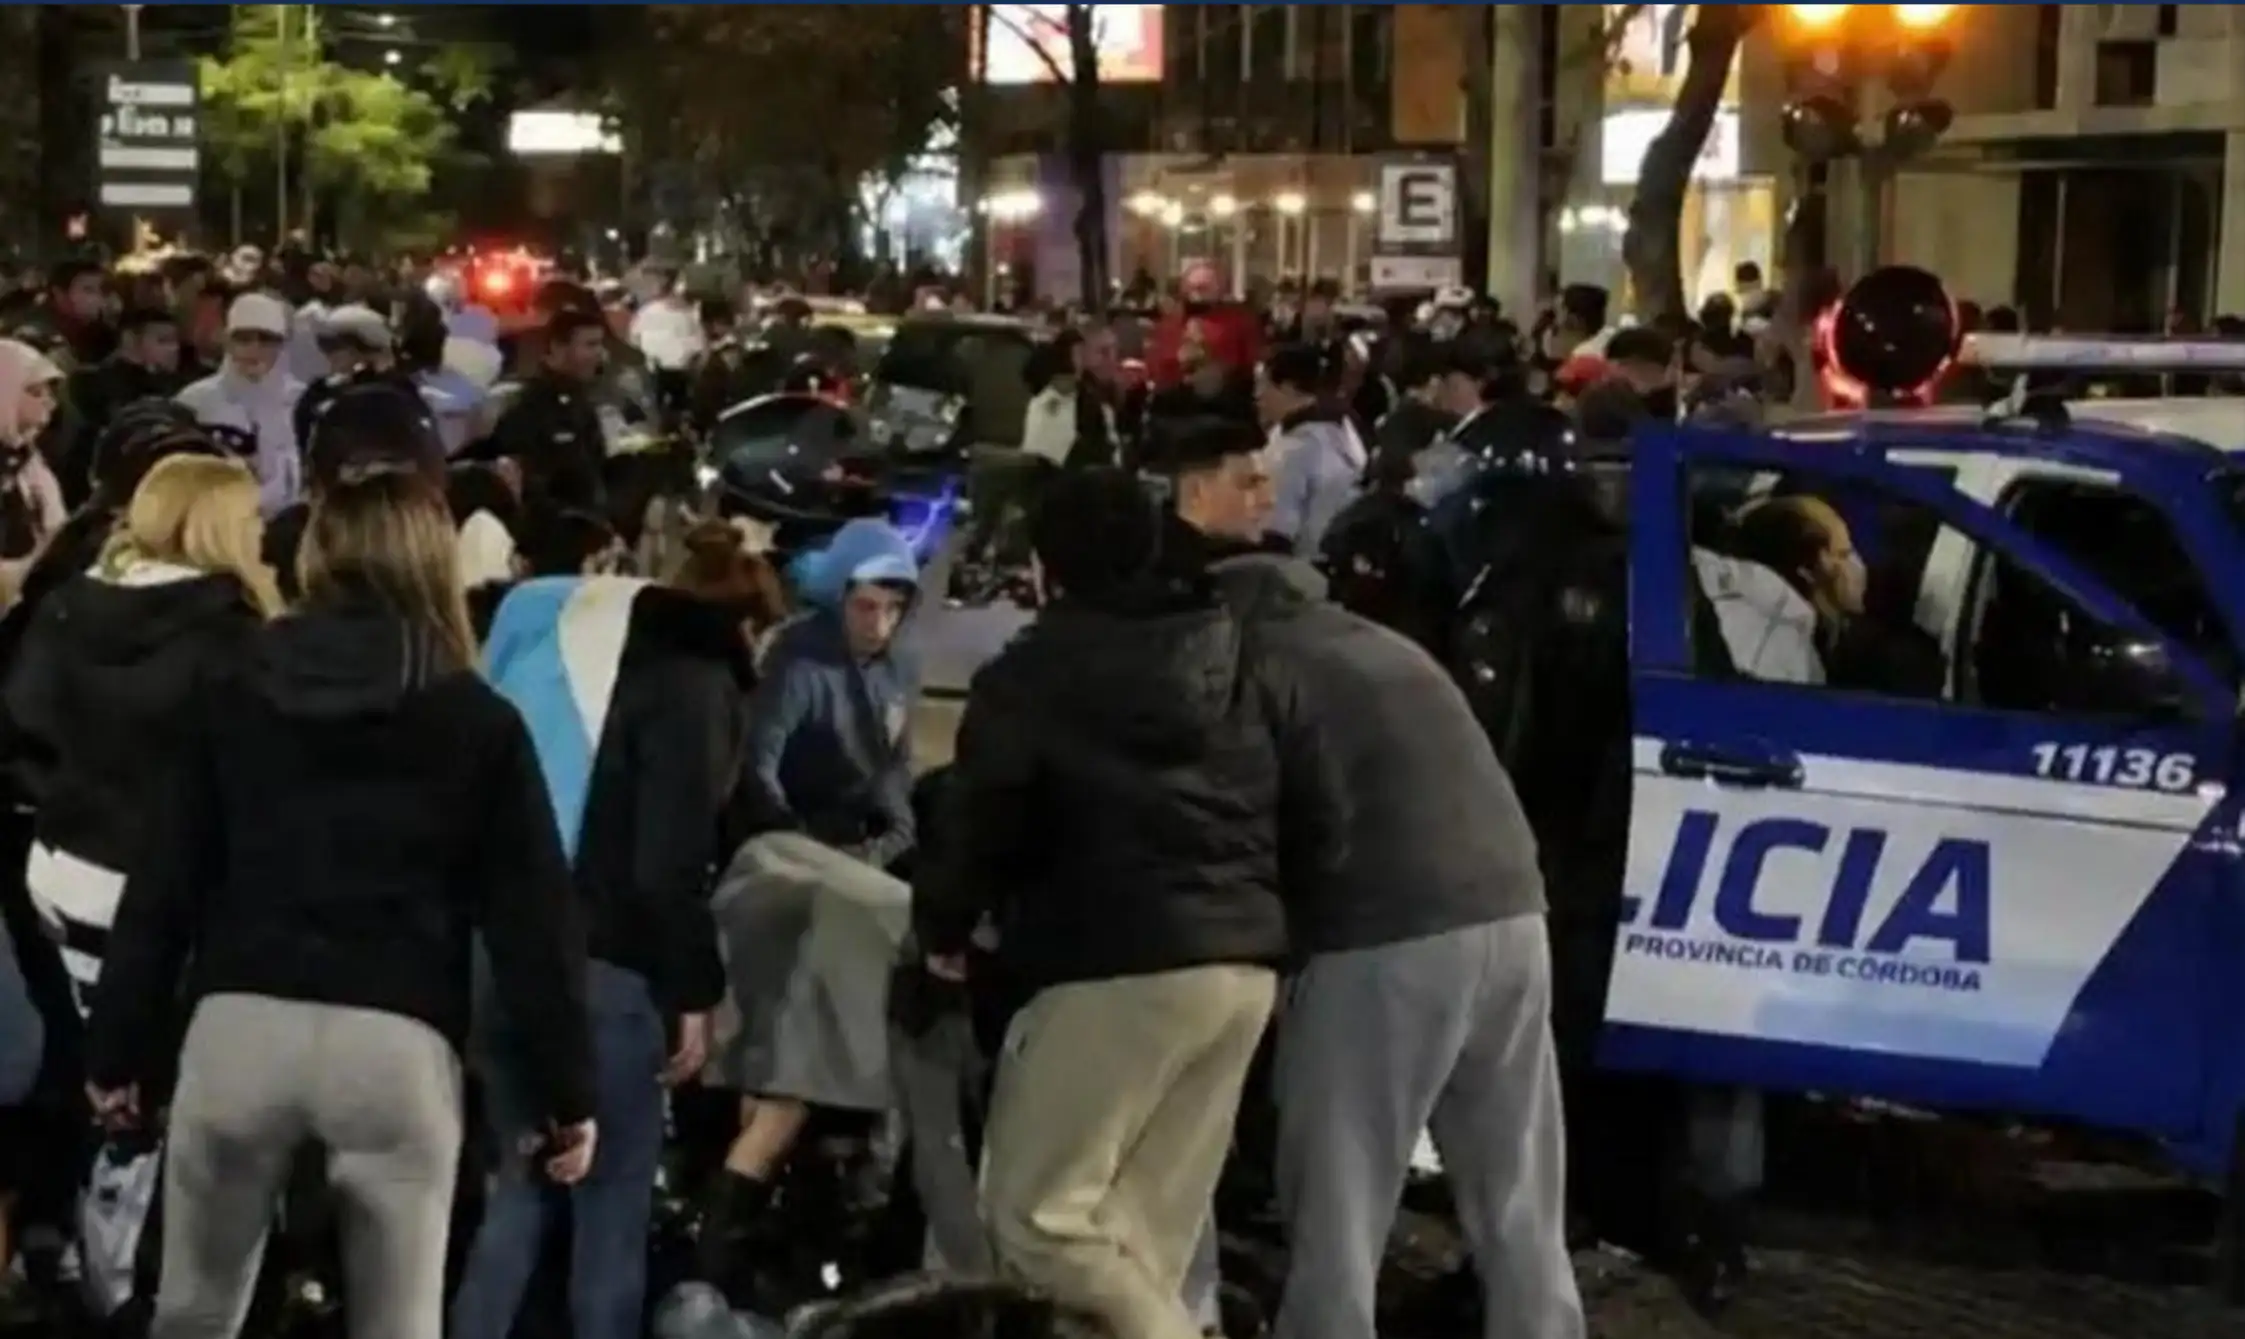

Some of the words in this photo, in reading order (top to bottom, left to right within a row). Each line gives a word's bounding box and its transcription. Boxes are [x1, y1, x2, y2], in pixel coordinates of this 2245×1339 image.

[1398, 172, 1441, 227] E
[2031, 742, 2196, 790] 11136
[1625, 932, 1784, 971] PROVINCIA
[1791, 952, 1830, 976] DE
